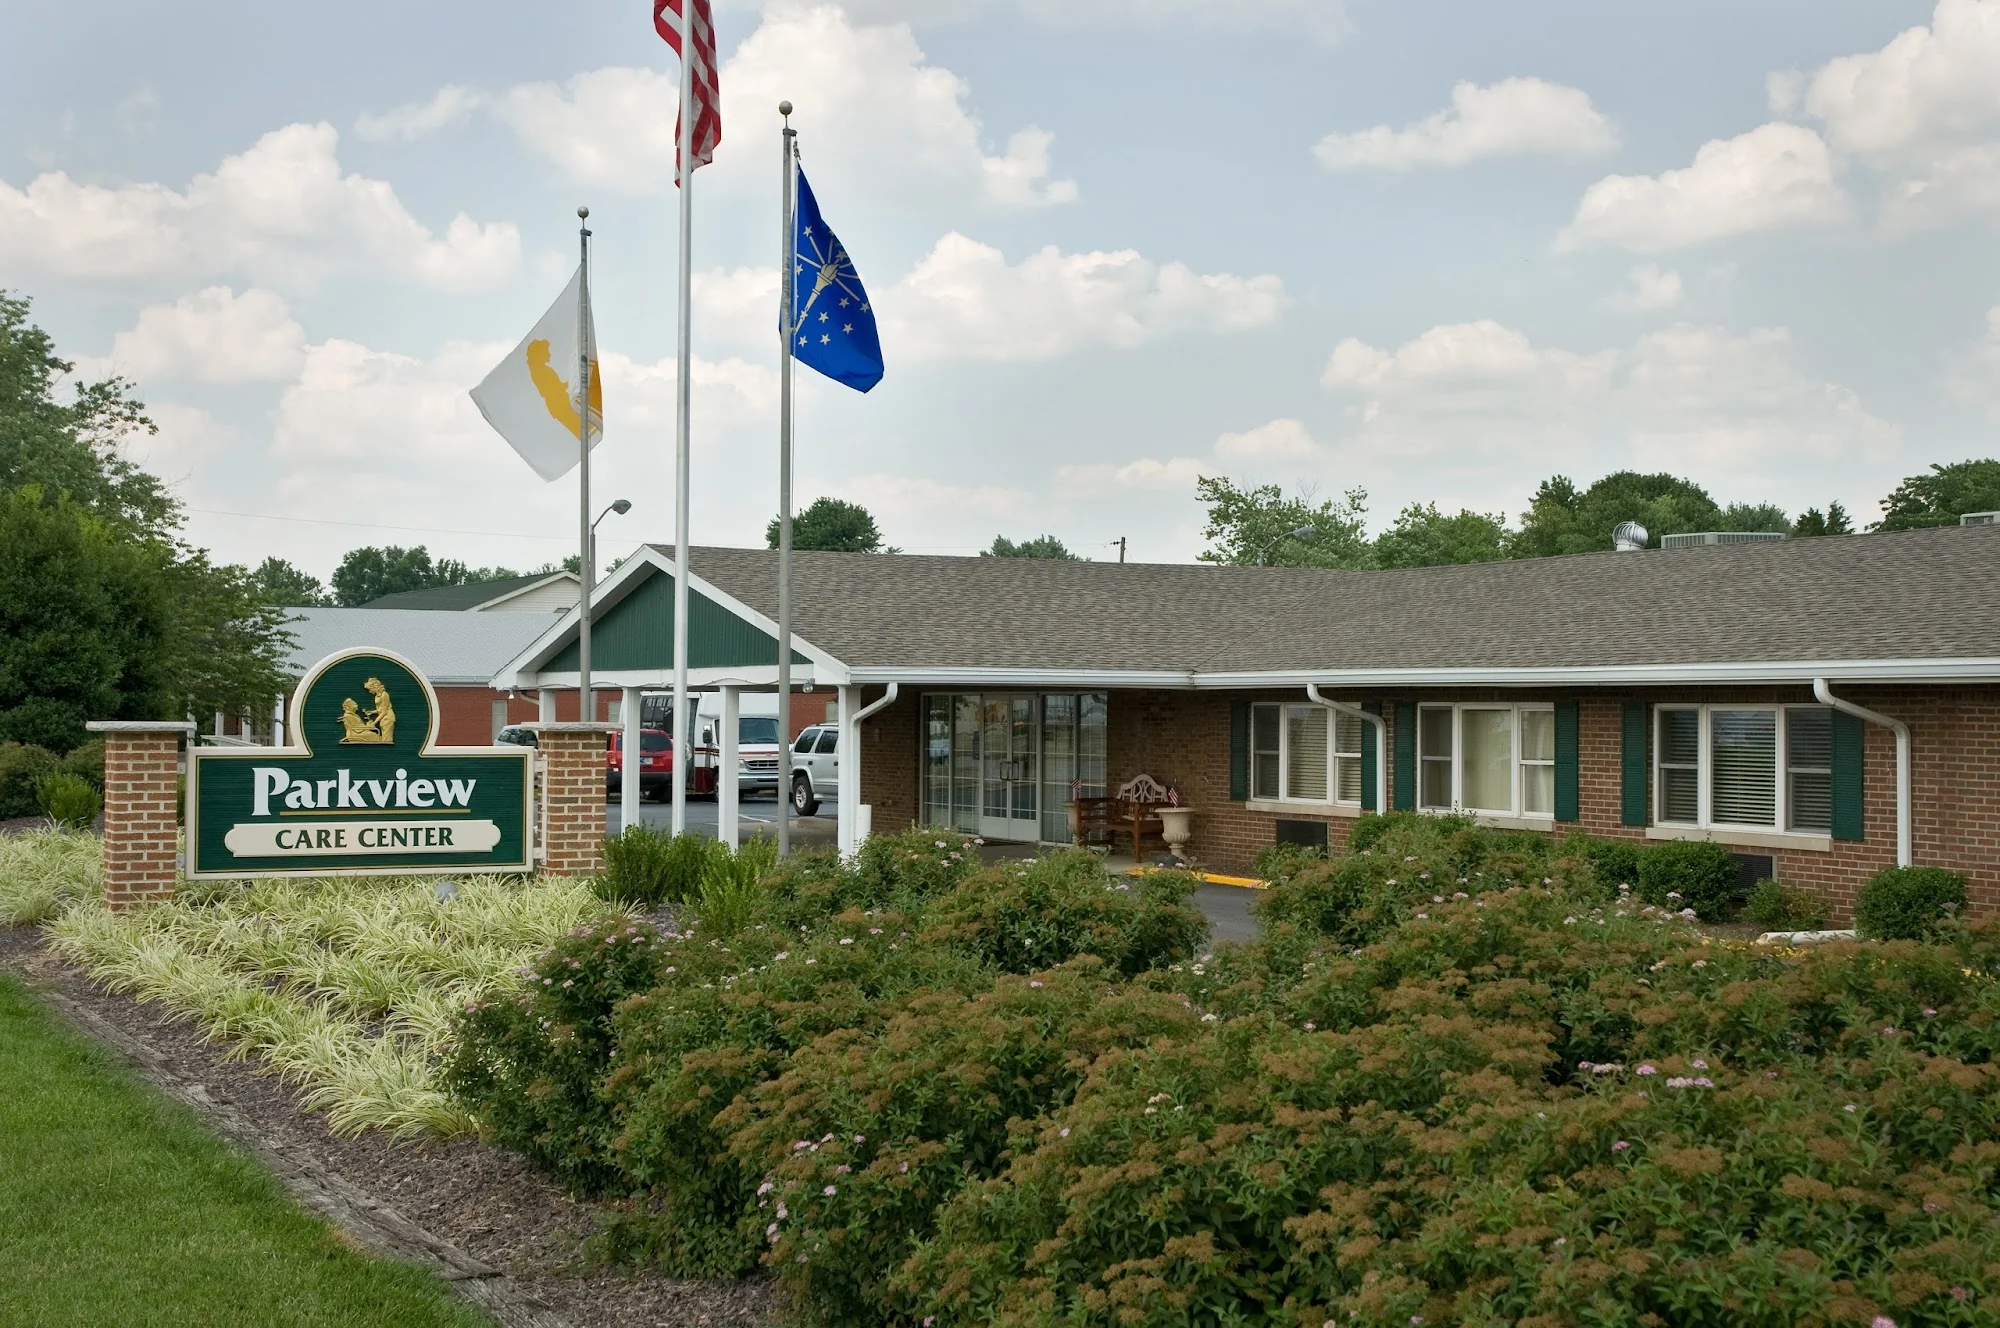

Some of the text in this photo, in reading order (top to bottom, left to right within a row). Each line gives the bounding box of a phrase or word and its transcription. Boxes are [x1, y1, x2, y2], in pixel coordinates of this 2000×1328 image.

[251, 767, 477, 816] Parkview
[275, 827, 454, 849] CARE CENTER
